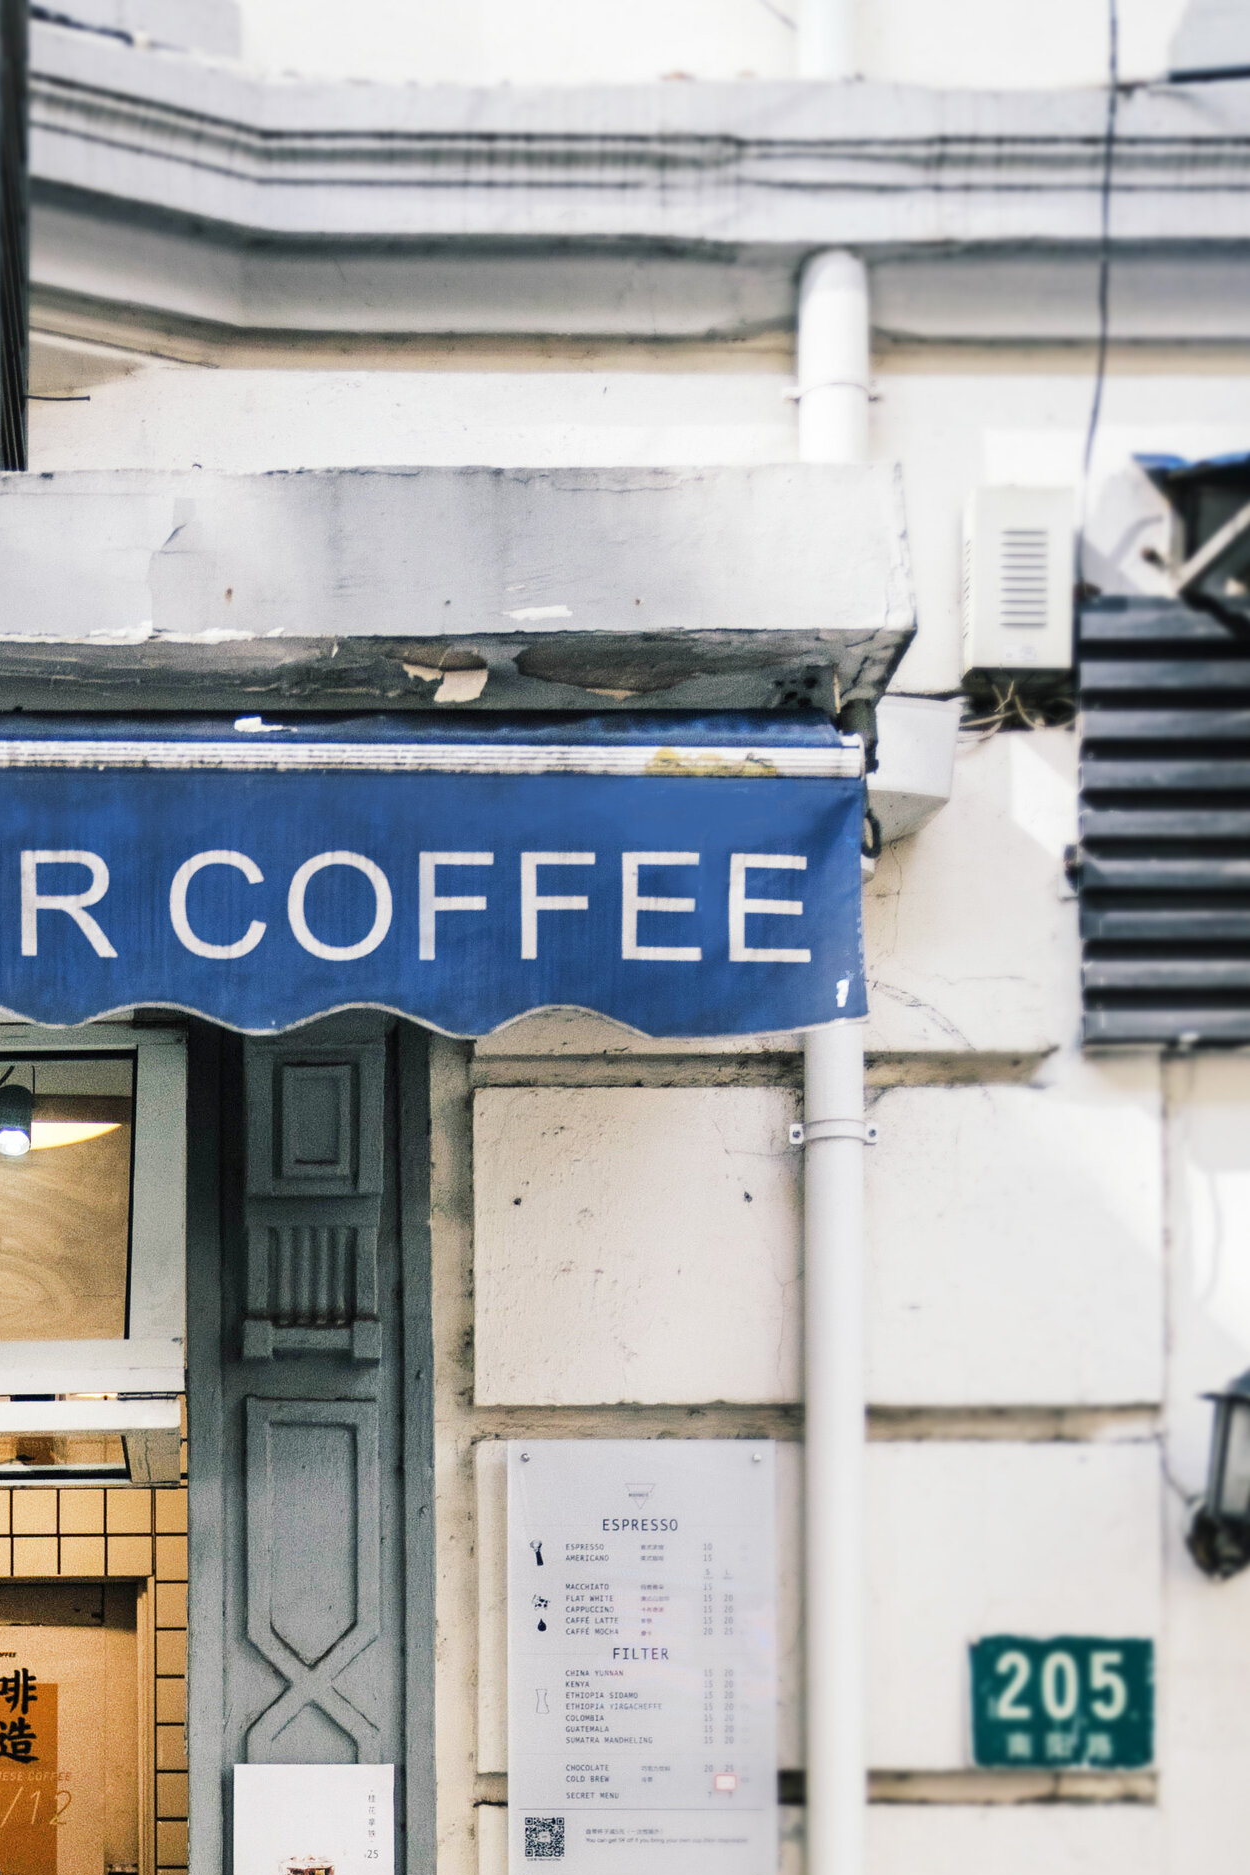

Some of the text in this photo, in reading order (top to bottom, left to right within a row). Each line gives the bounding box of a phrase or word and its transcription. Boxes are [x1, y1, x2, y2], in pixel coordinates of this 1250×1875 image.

[169, 849, 812, 963] COFFEE
[602, 1519, 678, 1531] ESPRESSO
[703, 1543, 713, 1551] 10
[703, 1554, 713, 1562] 15
[703, 1594, 713, 1602] 15
[724, 1594, 734, 1602] 20
[703, 1606, 713, 1614] 15
[595, 1616, 619, 1624] LATTE
[703, 1616, 713, 1625] 15
[724, 1616, 734, 1625] 20
[595, 1627, 619, 1635] MOCHA
[703, 1627, 713, 1636] 20
[613, 1648, 669, 1660] FILTER
[996, 1650, 1128, 1720] 205
[28, 1771, 72, 1782] COFFEE
